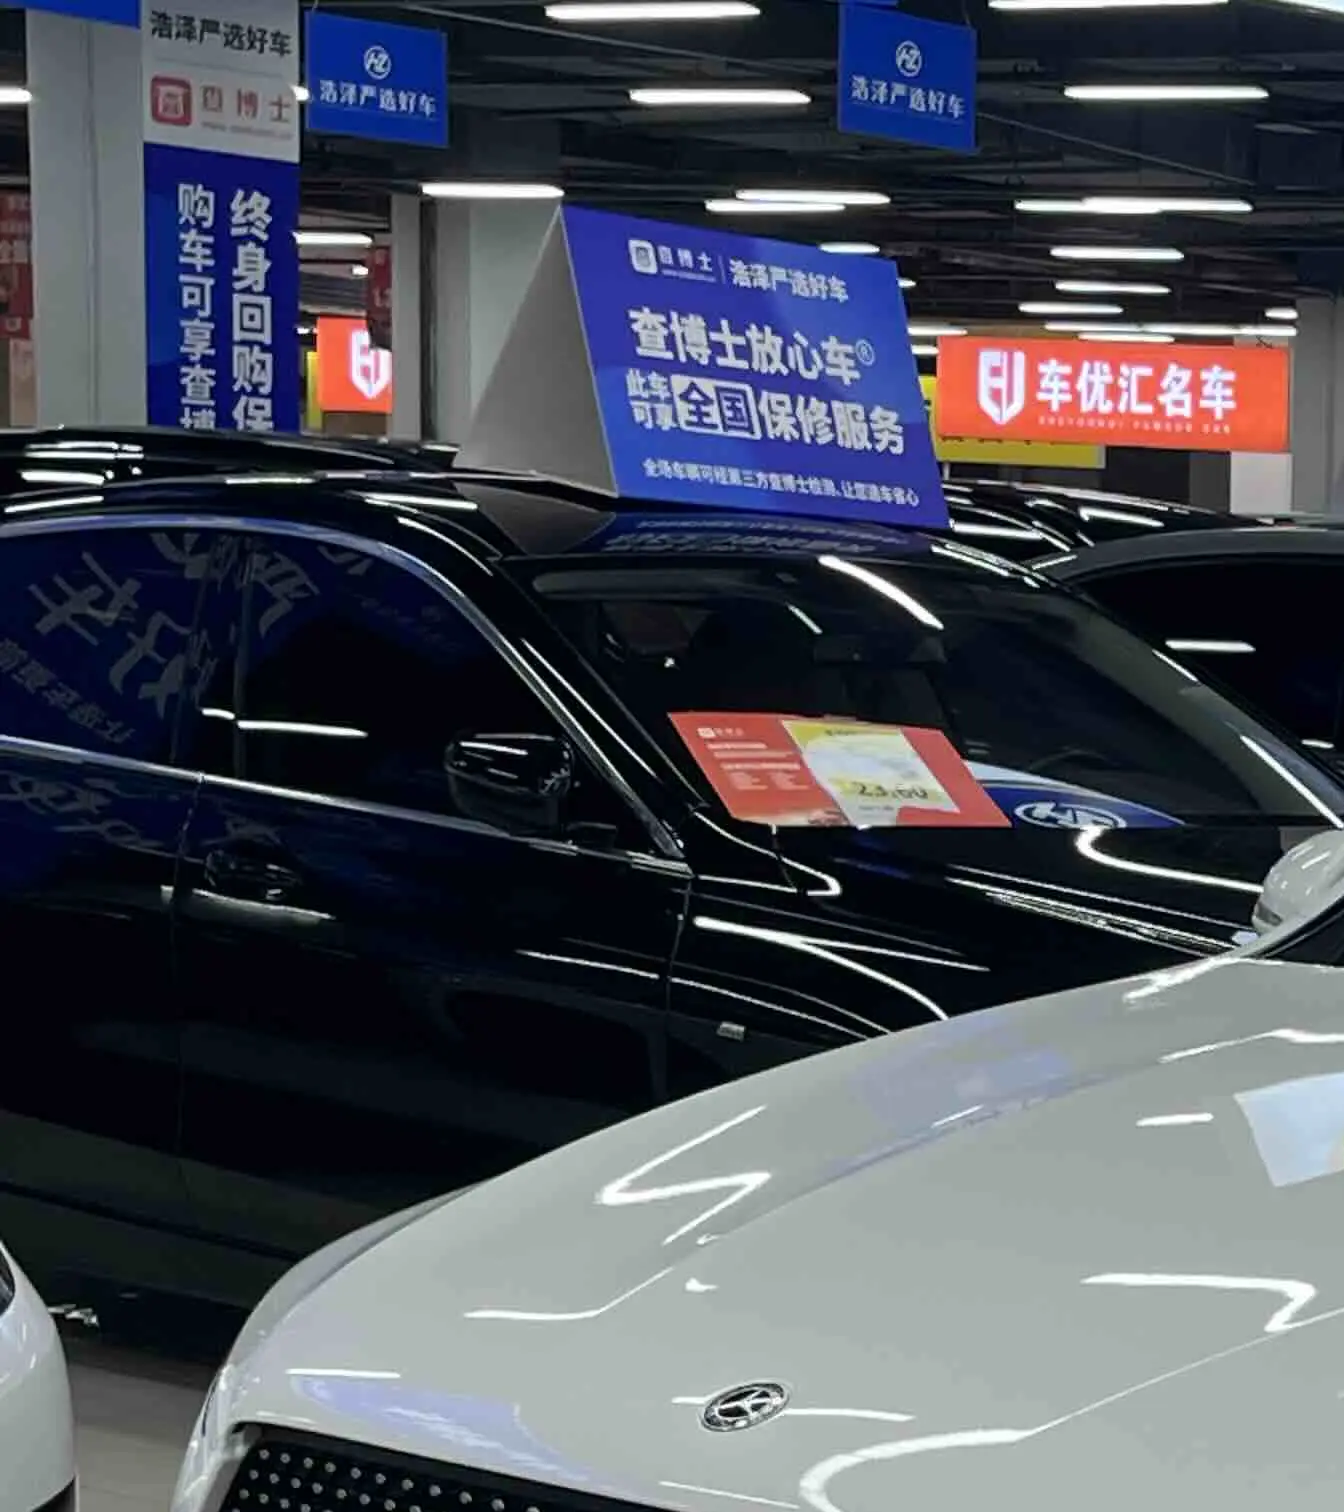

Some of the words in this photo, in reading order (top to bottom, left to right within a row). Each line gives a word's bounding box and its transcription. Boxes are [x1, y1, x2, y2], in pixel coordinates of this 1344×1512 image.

[151, 10, 292, 58] 浩泽严选好车
[673, 374, 905, 455] 全国保修服务
[1035, 357, 1238, 421] 车优汇名车
